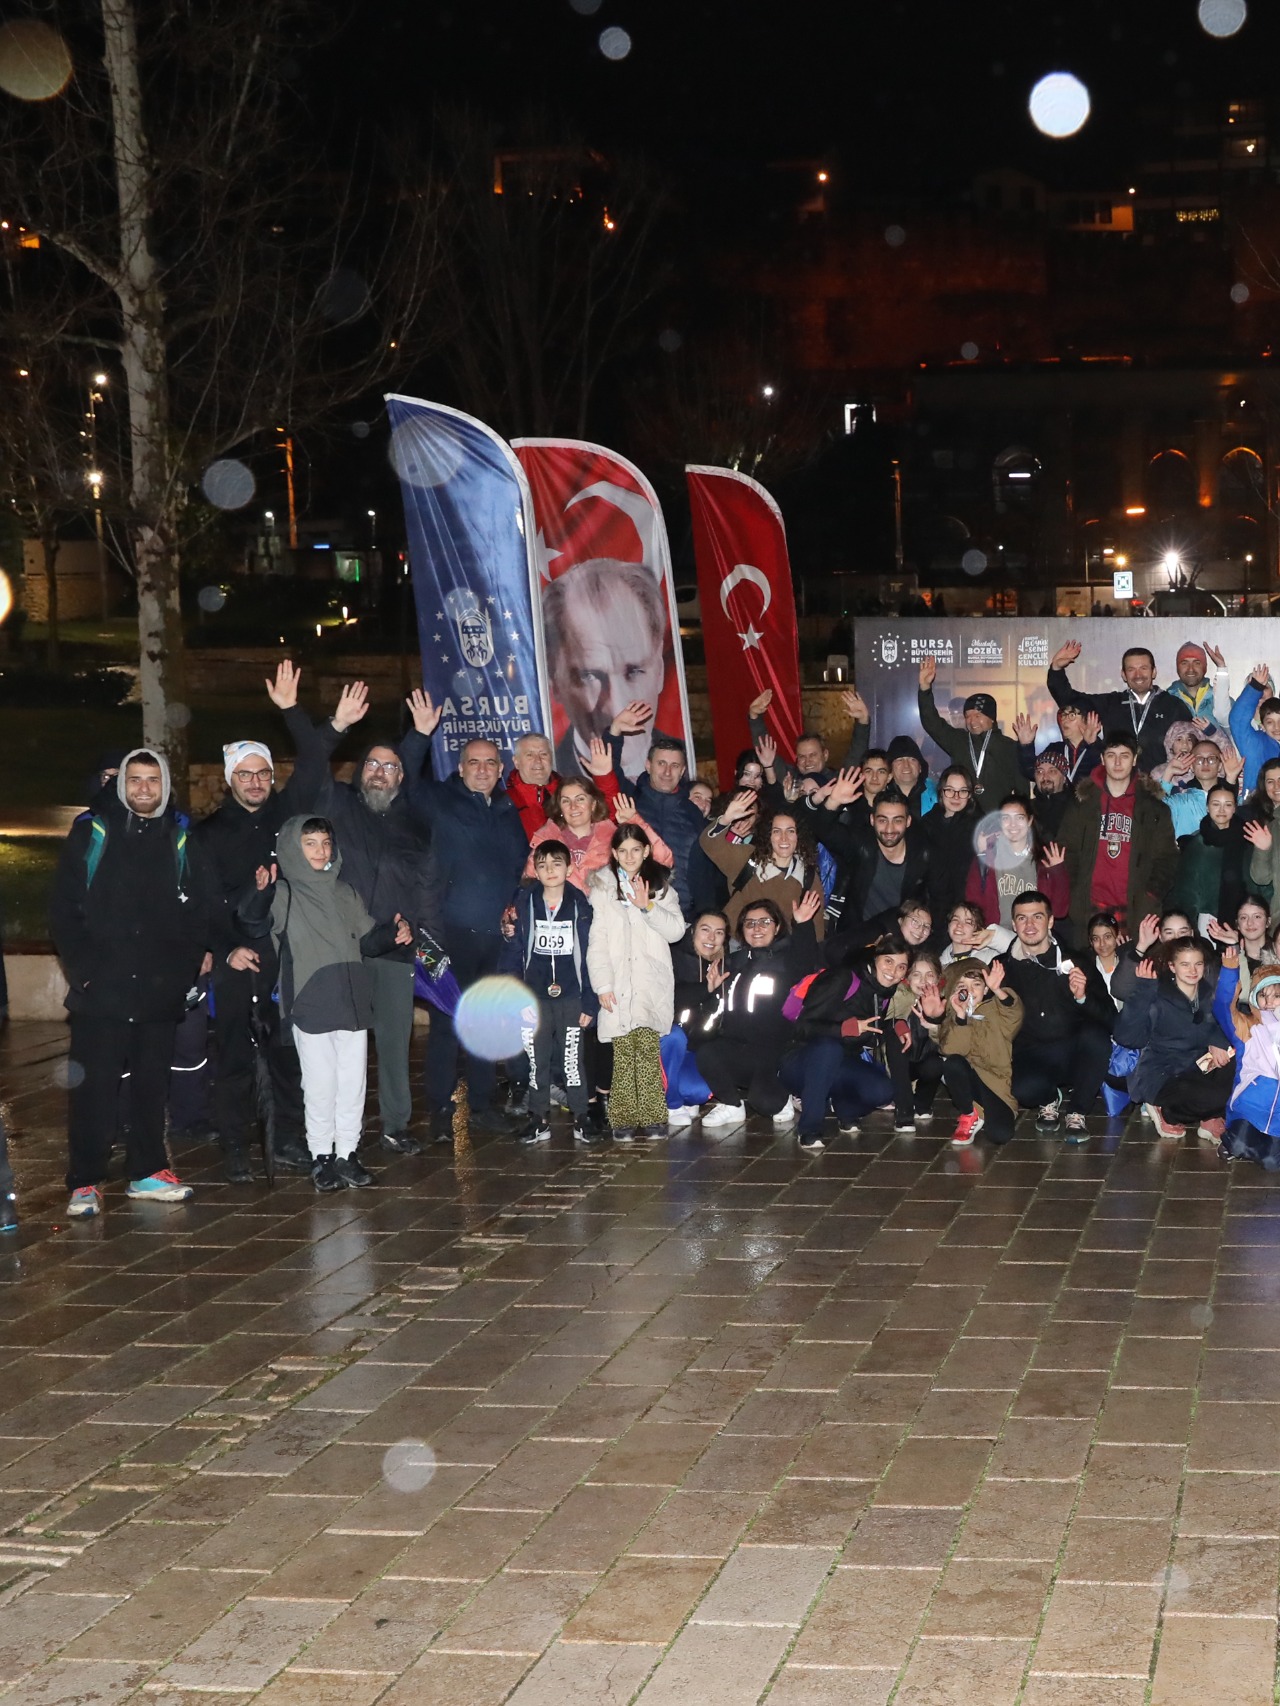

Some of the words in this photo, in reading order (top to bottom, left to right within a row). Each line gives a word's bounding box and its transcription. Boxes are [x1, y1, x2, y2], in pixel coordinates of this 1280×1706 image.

[911, 639, 953, 648] BURSA
[911, 648, 953, 656] BÜYÜKŞEHİR
[967, 647, 1003, 655] BOZBEY
[539, 935, 564, 949] 059
[564, 1026, 581, 1087] BROOKLYN
